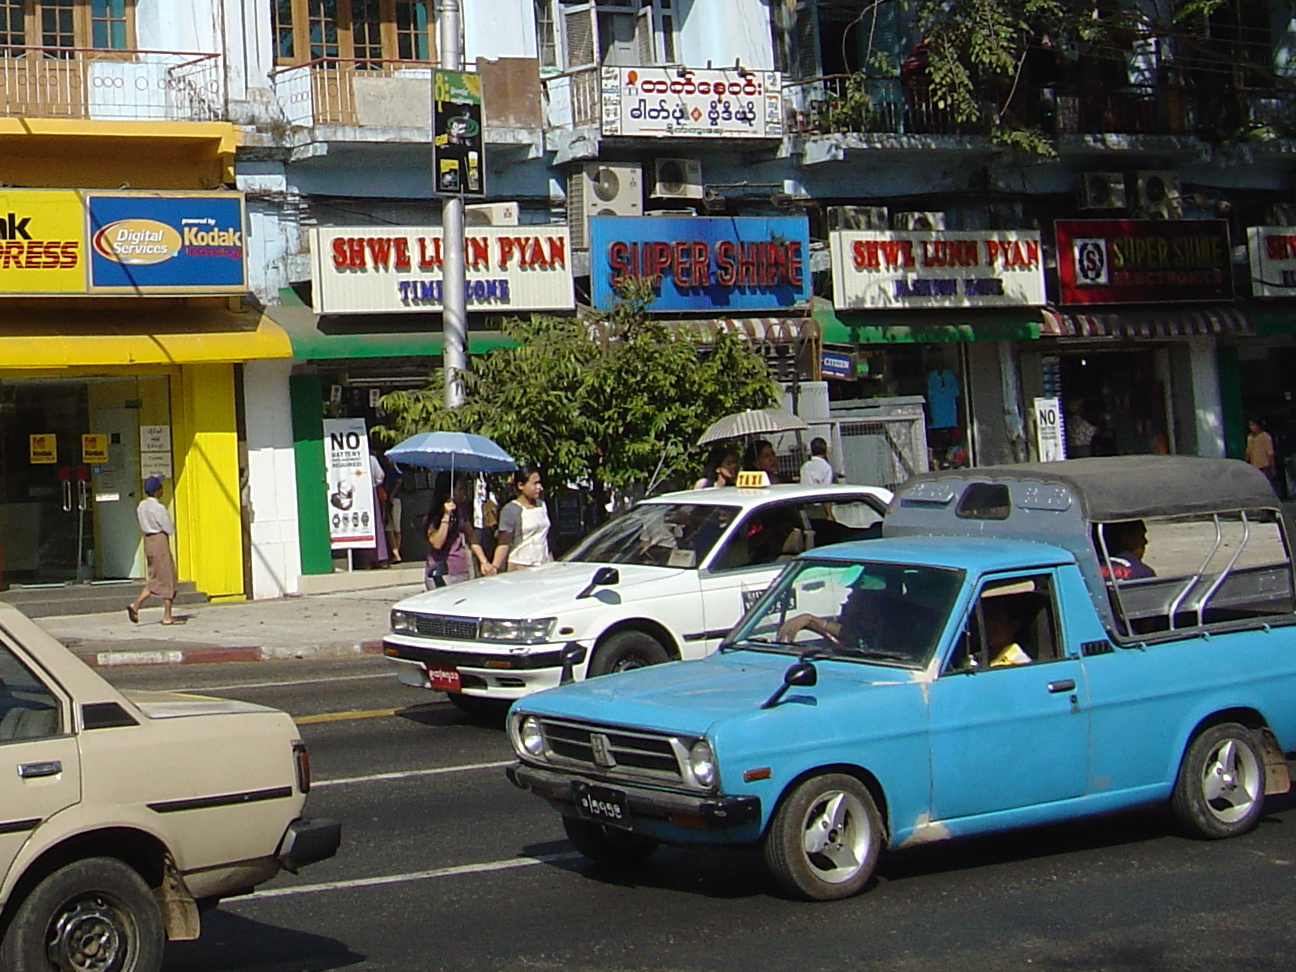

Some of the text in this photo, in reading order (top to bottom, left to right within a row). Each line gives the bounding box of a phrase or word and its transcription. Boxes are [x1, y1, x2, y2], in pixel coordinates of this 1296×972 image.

[181, 217, 216, 226] powered by
[116, 229, 164, 245] Digital
[183, 226, 242, 246] Kodak
[112, 242, 168, 255] Services
[332, 237, 411, 269] SHWE
[498, 236, 566, 267] PYAN
[852, 240, 915, 268] SHWE
[983, 239, 1040, 267] PYAN
[1112, 237, 1169, 268] SUPER
[1174, 236, 1221, 268] SHINE
[608, 240, 803, 287] SUPER SHINE
[1039, 409, 1056, 426] NO
[330, 431, 361, 451] NO
[739, 475, 763, 485] TAXI
